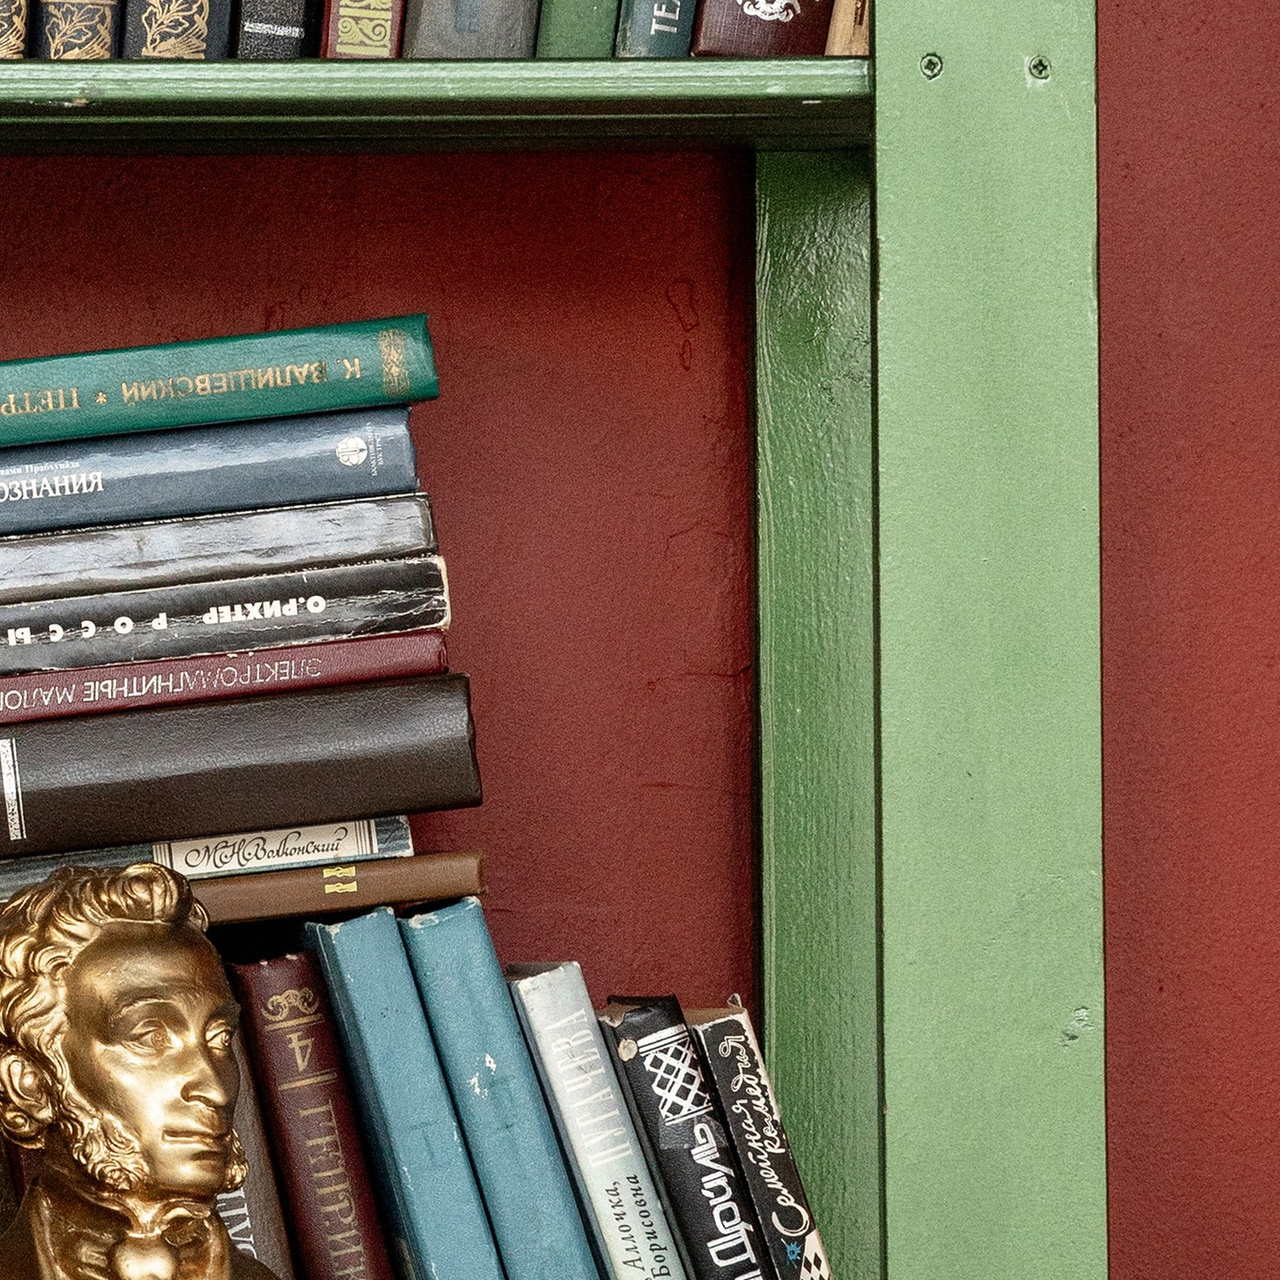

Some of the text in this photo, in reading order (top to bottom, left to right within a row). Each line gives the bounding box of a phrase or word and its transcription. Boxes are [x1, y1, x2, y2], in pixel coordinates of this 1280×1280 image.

[0, 387, 81, 416] ПЕТР
[121, 360, 327, 407] ВАЛИШЕВСКИЙ
[83, 656, 324, 703] ЭЛЕКТРОМАГНИТНЫЕ
[543, 1007, 635, 1169] ПУГАЧЕВА
[729, 1097, 811, 1238] Семейная
[604, 1180, 647, 1272] Аллочка,
[629, 1174, 672, 1279] Борисовна
